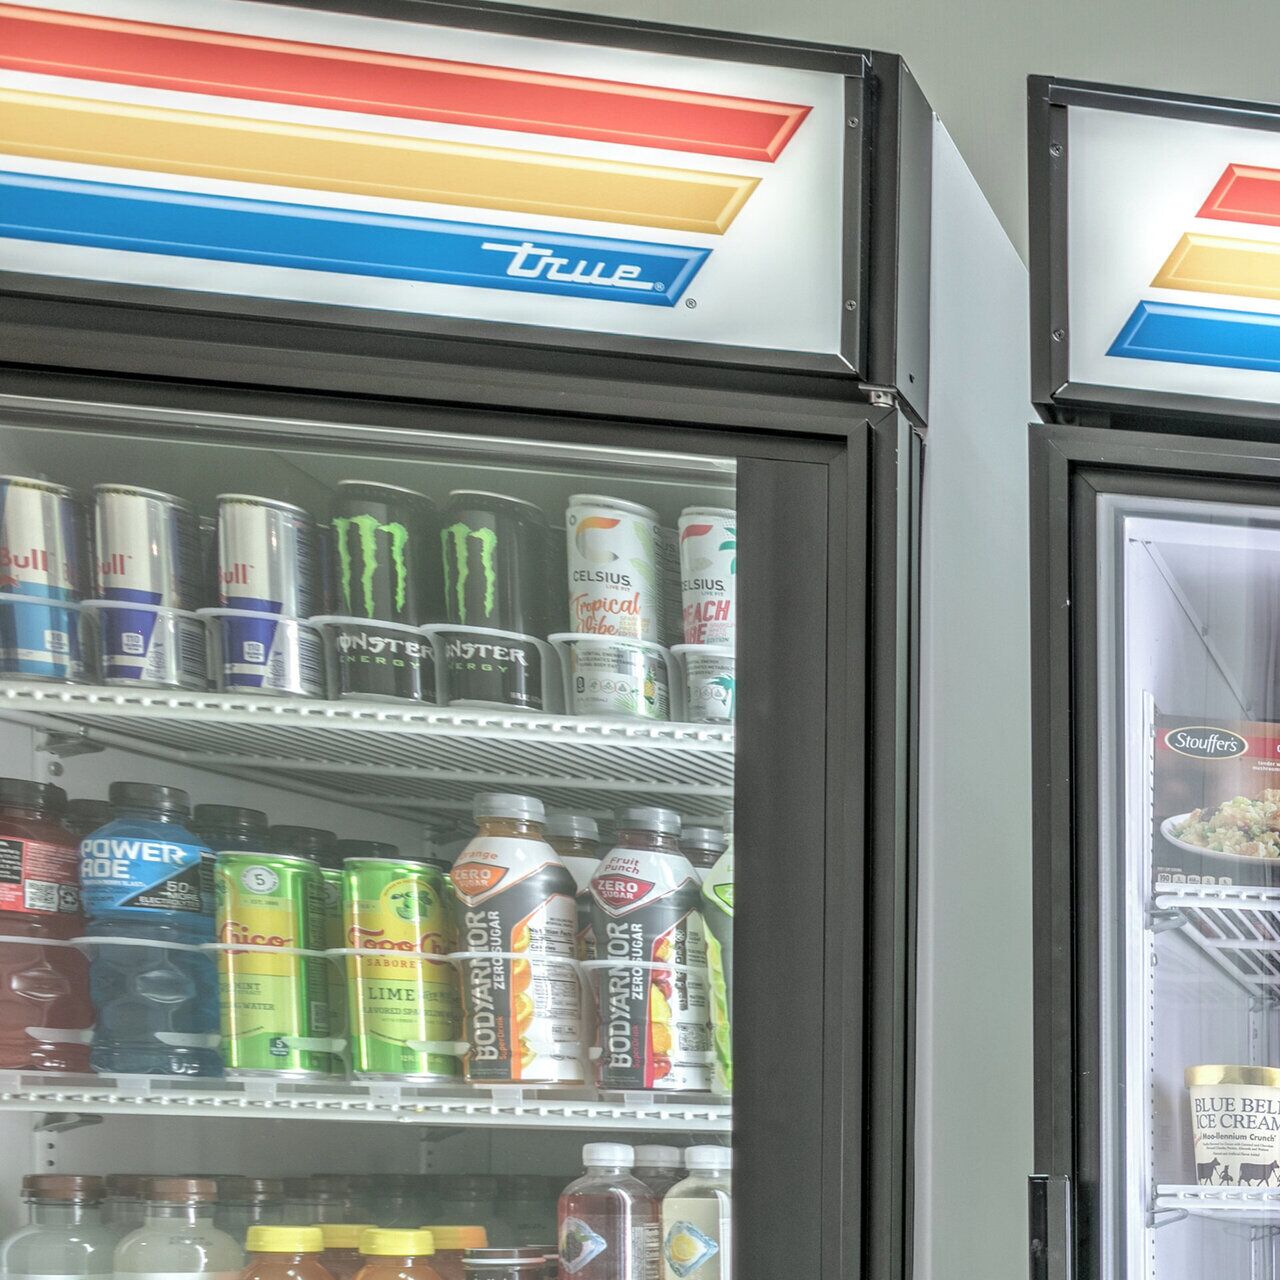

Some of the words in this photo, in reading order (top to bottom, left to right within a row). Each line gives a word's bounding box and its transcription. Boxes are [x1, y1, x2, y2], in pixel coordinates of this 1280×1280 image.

[481, 242, 654, 291] true
[573, 570, 630, 585] CELSIUS
[571, 592, 640, 621] Tropical
[1175, 731, 1237, 757] Stouffer's
[81, 839, 187, 865] POWER
[609, 855, 641, 867] Fruit
[81, 859, 130, 879] ADE
[454, 868, 492, 880] ZERO
[604, 863, 641, 875] Punch
[598, 880, 639, 893] ZERO
[602, 890, 635, 900] SUGAR
[368, 987, 415, 1001] LIME
[1195, 1097, 1235, 1114] BLUE
[1196, 1115, 1218, 1131] ICE
[1249, 1134, 1275, 1142] Crunch
